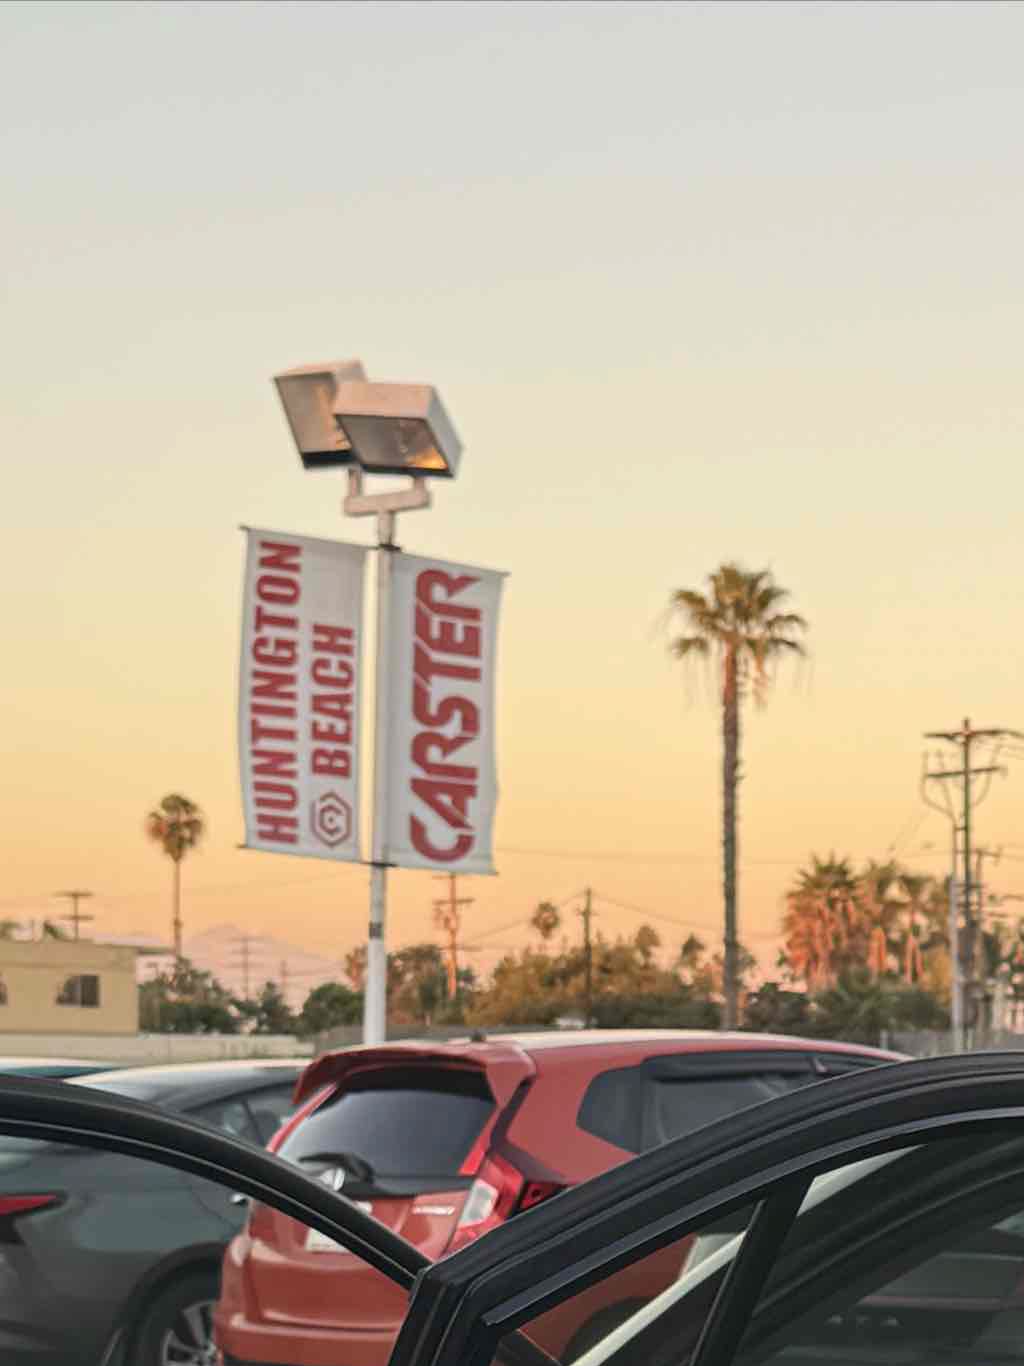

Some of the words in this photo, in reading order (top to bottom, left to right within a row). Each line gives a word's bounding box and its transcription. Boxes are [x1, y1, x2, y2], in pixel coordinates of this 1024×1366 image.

[250, 540, 302, 845] HUNTINGTON
[311, 623, 354, 779] BEACH
[410, 568, 482, 863] CARSTER
